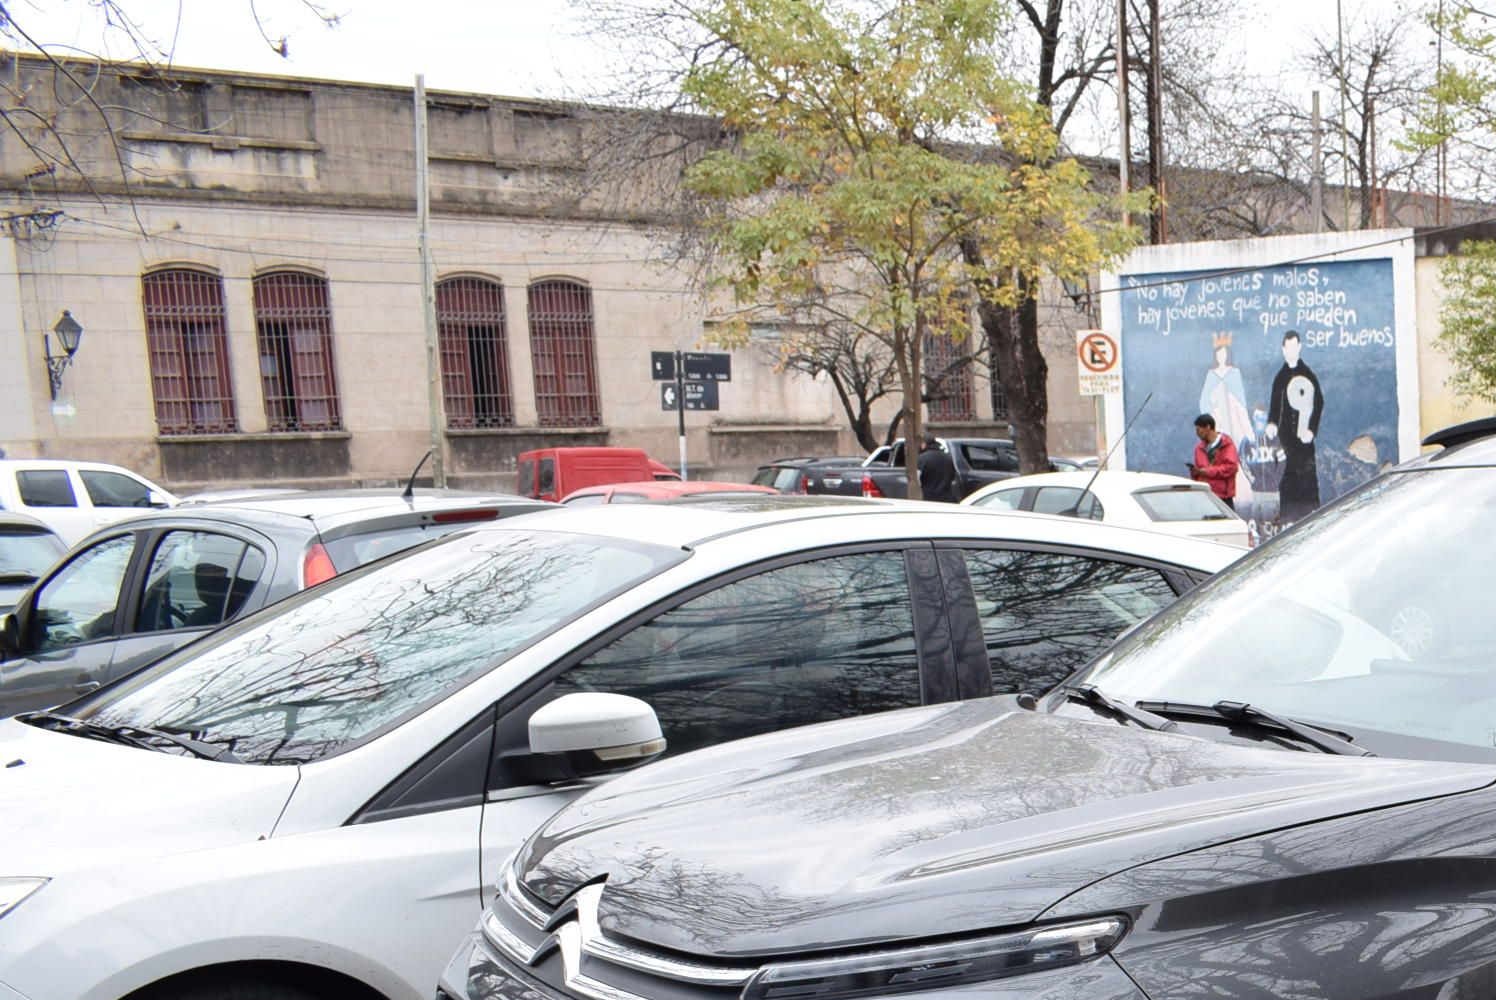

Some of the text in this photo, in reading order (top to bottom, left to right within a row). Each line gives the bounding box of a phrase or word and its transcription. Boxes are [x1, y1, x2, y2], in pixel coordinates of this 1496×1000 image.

[1163, 278, 1188, 306] hay
[1138, 287, 1346, 336] hay jóvenes que no saben
[1259, 305, 1357, 336] que pueden
[1305, 326, 1393, 348] ser buenos
